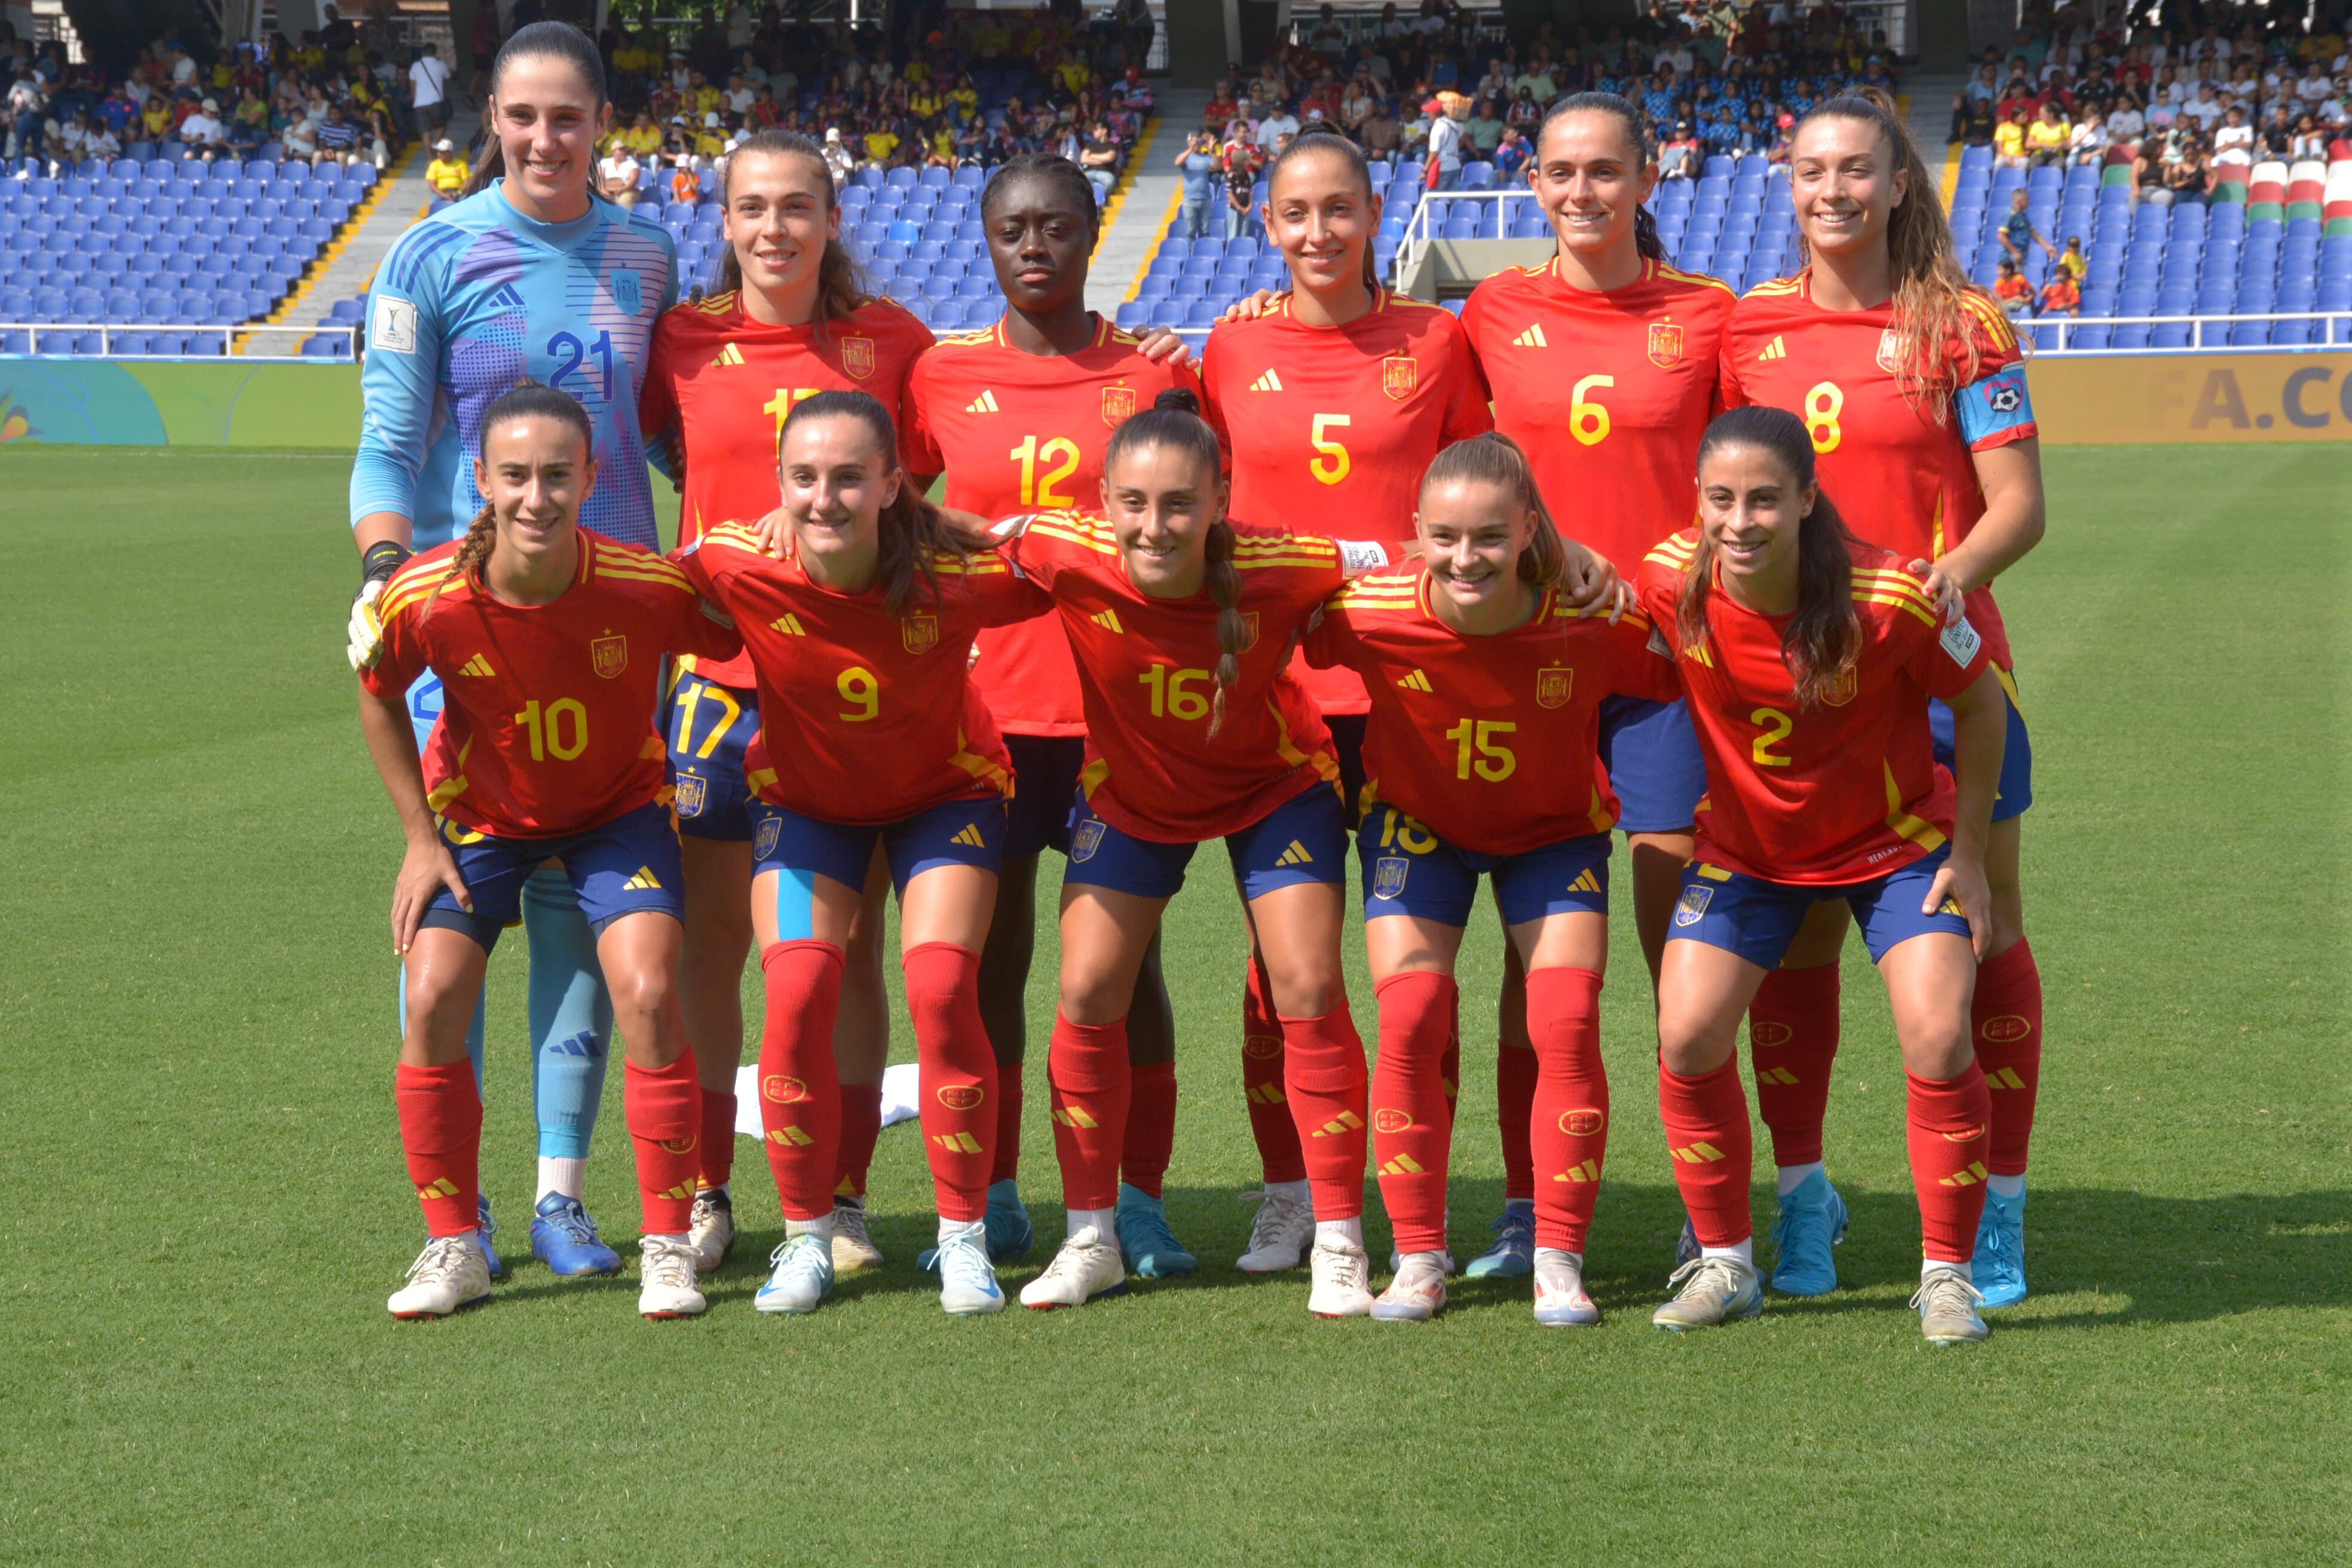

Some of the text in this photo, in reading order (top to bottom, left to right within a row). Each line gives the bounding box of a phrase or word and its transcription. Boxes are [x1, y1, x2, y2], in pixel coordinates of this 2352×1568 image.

[546, 330, 612, 401] 21
[764, 388, 822, 460] 1
[1569, 374, 1614, 446] 6
[1805, 381, 1843, 454] 8
[1010, 435, 1080, 507] 12
[1310, 414, 1350, 485] 5
[676, 682, 740, 759] 17
[837, 666, 878, 722] 9
[1139, 664, 1209, 721] 16
[515, 697, 589, 761] 10
[1446, 718, 1517, 783] 15
[1750, 708, 1793, 766] 2
